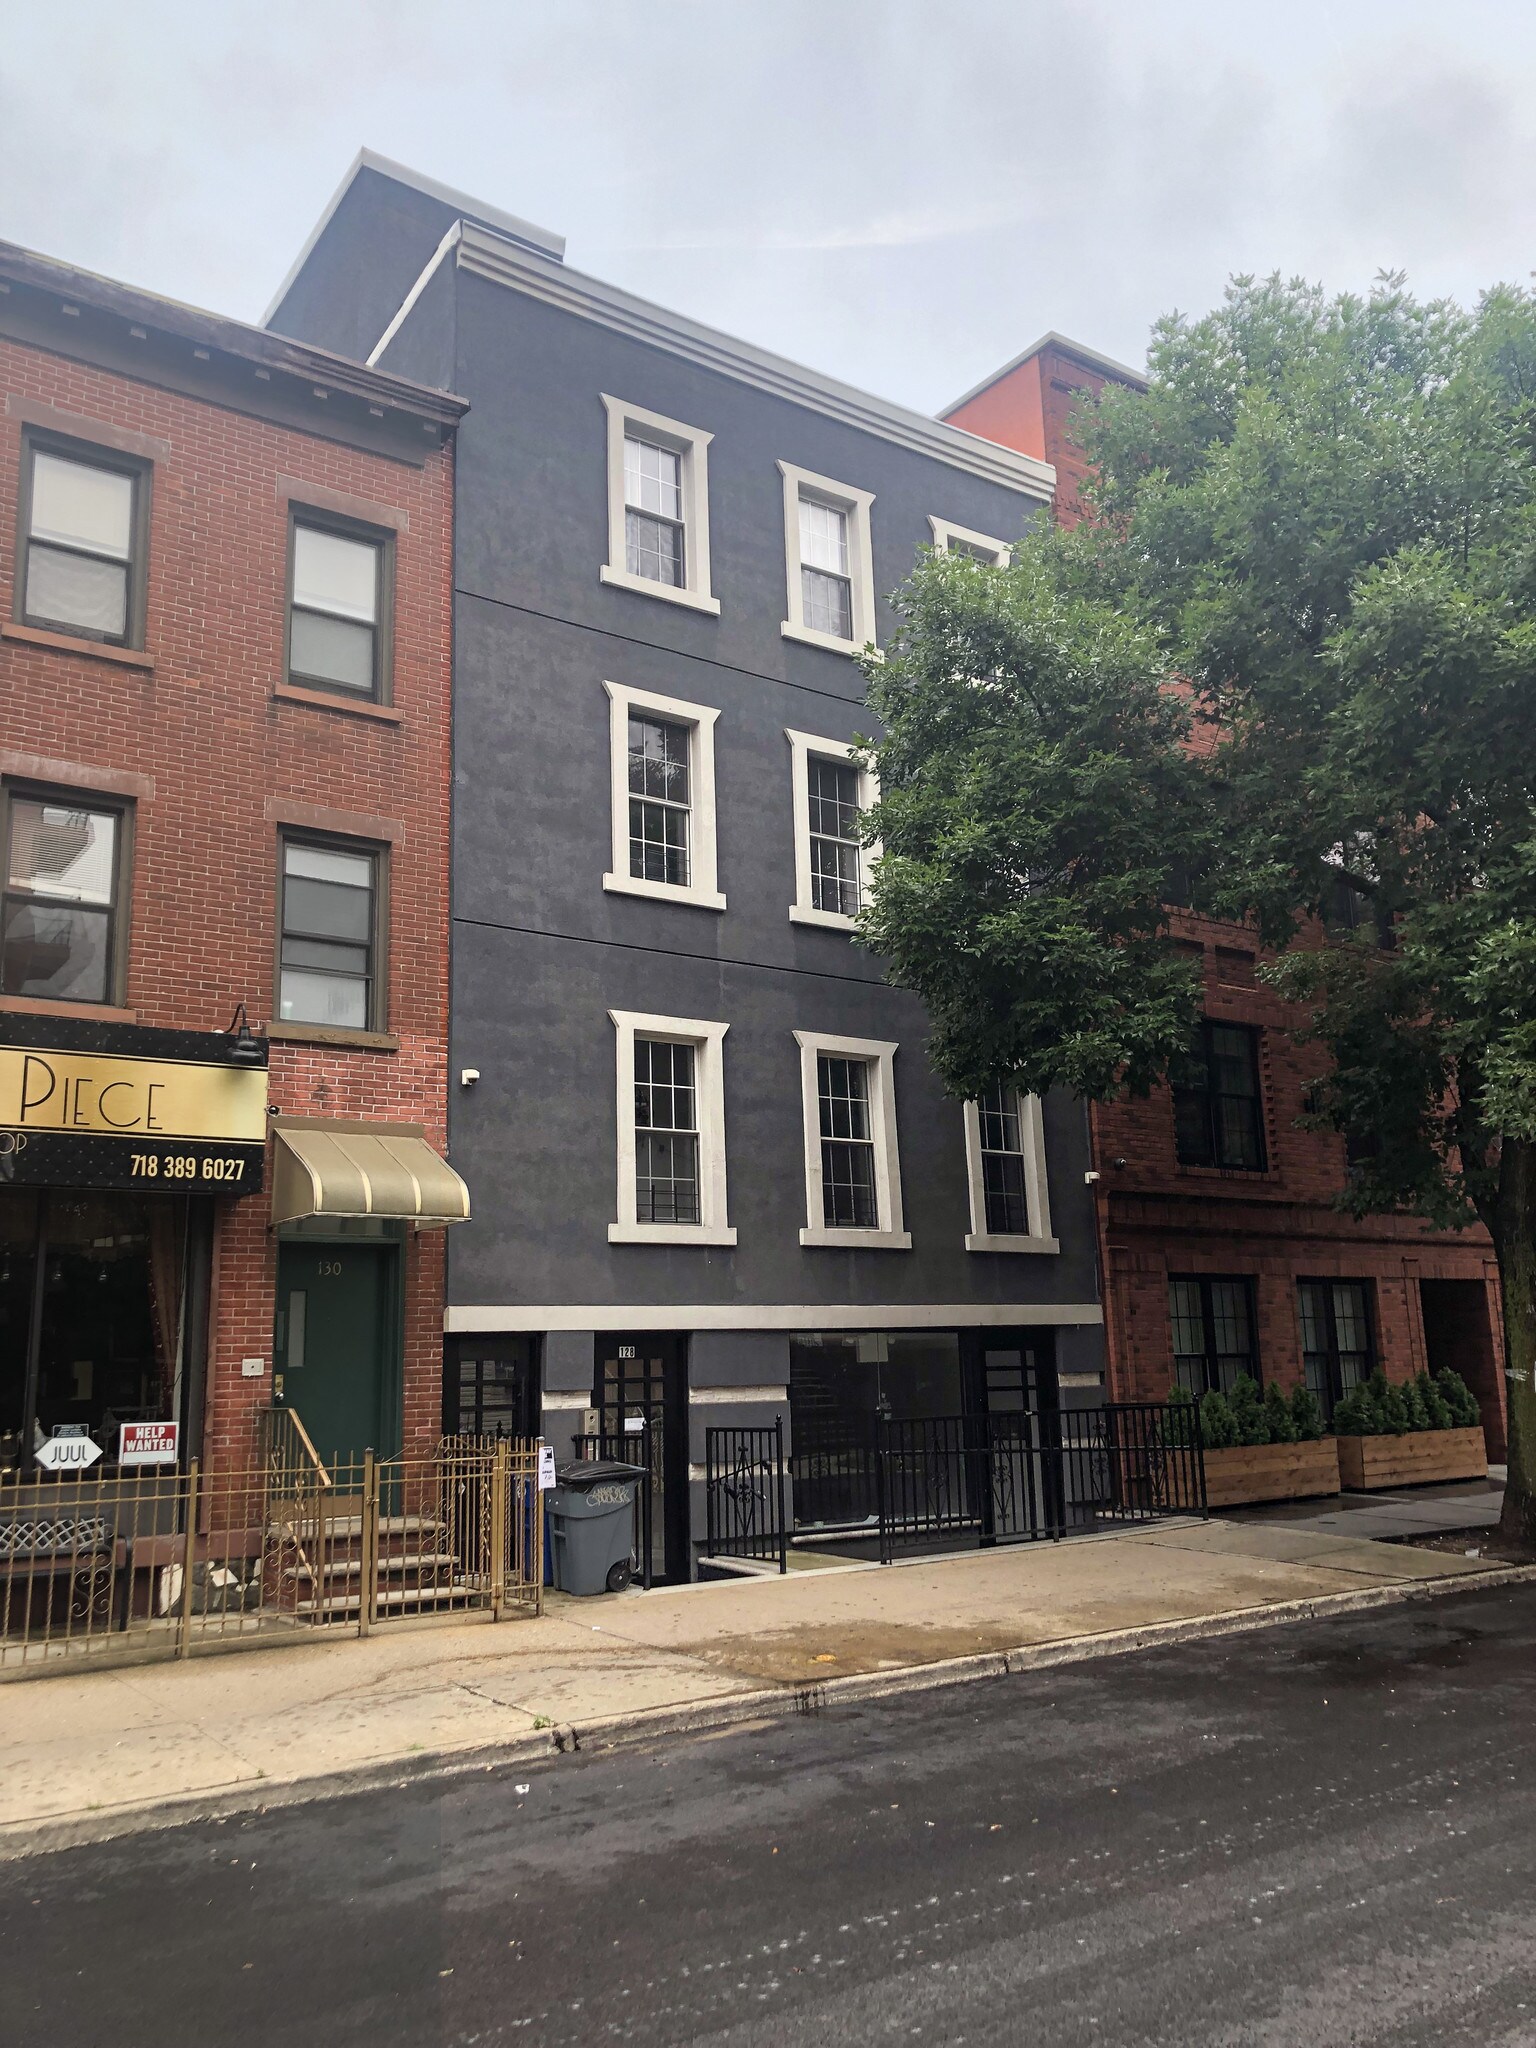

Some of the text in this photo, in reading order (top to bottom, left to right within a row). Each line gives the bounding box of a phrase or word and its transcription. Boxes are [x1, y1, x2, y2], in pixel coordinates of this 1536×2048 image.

[20, 1055, 165, 1130] PIECE
[130, 1154, 245, 1181] 718 389 6027
[318, 1260, 342, 1276] 130
[620, 1347, 634, 1357] 128
[136, 1426, 166, 1439] HELP
[126, 1438, 174, 1452] WANTED
[51, 1444, 87, 1463] JUUL
